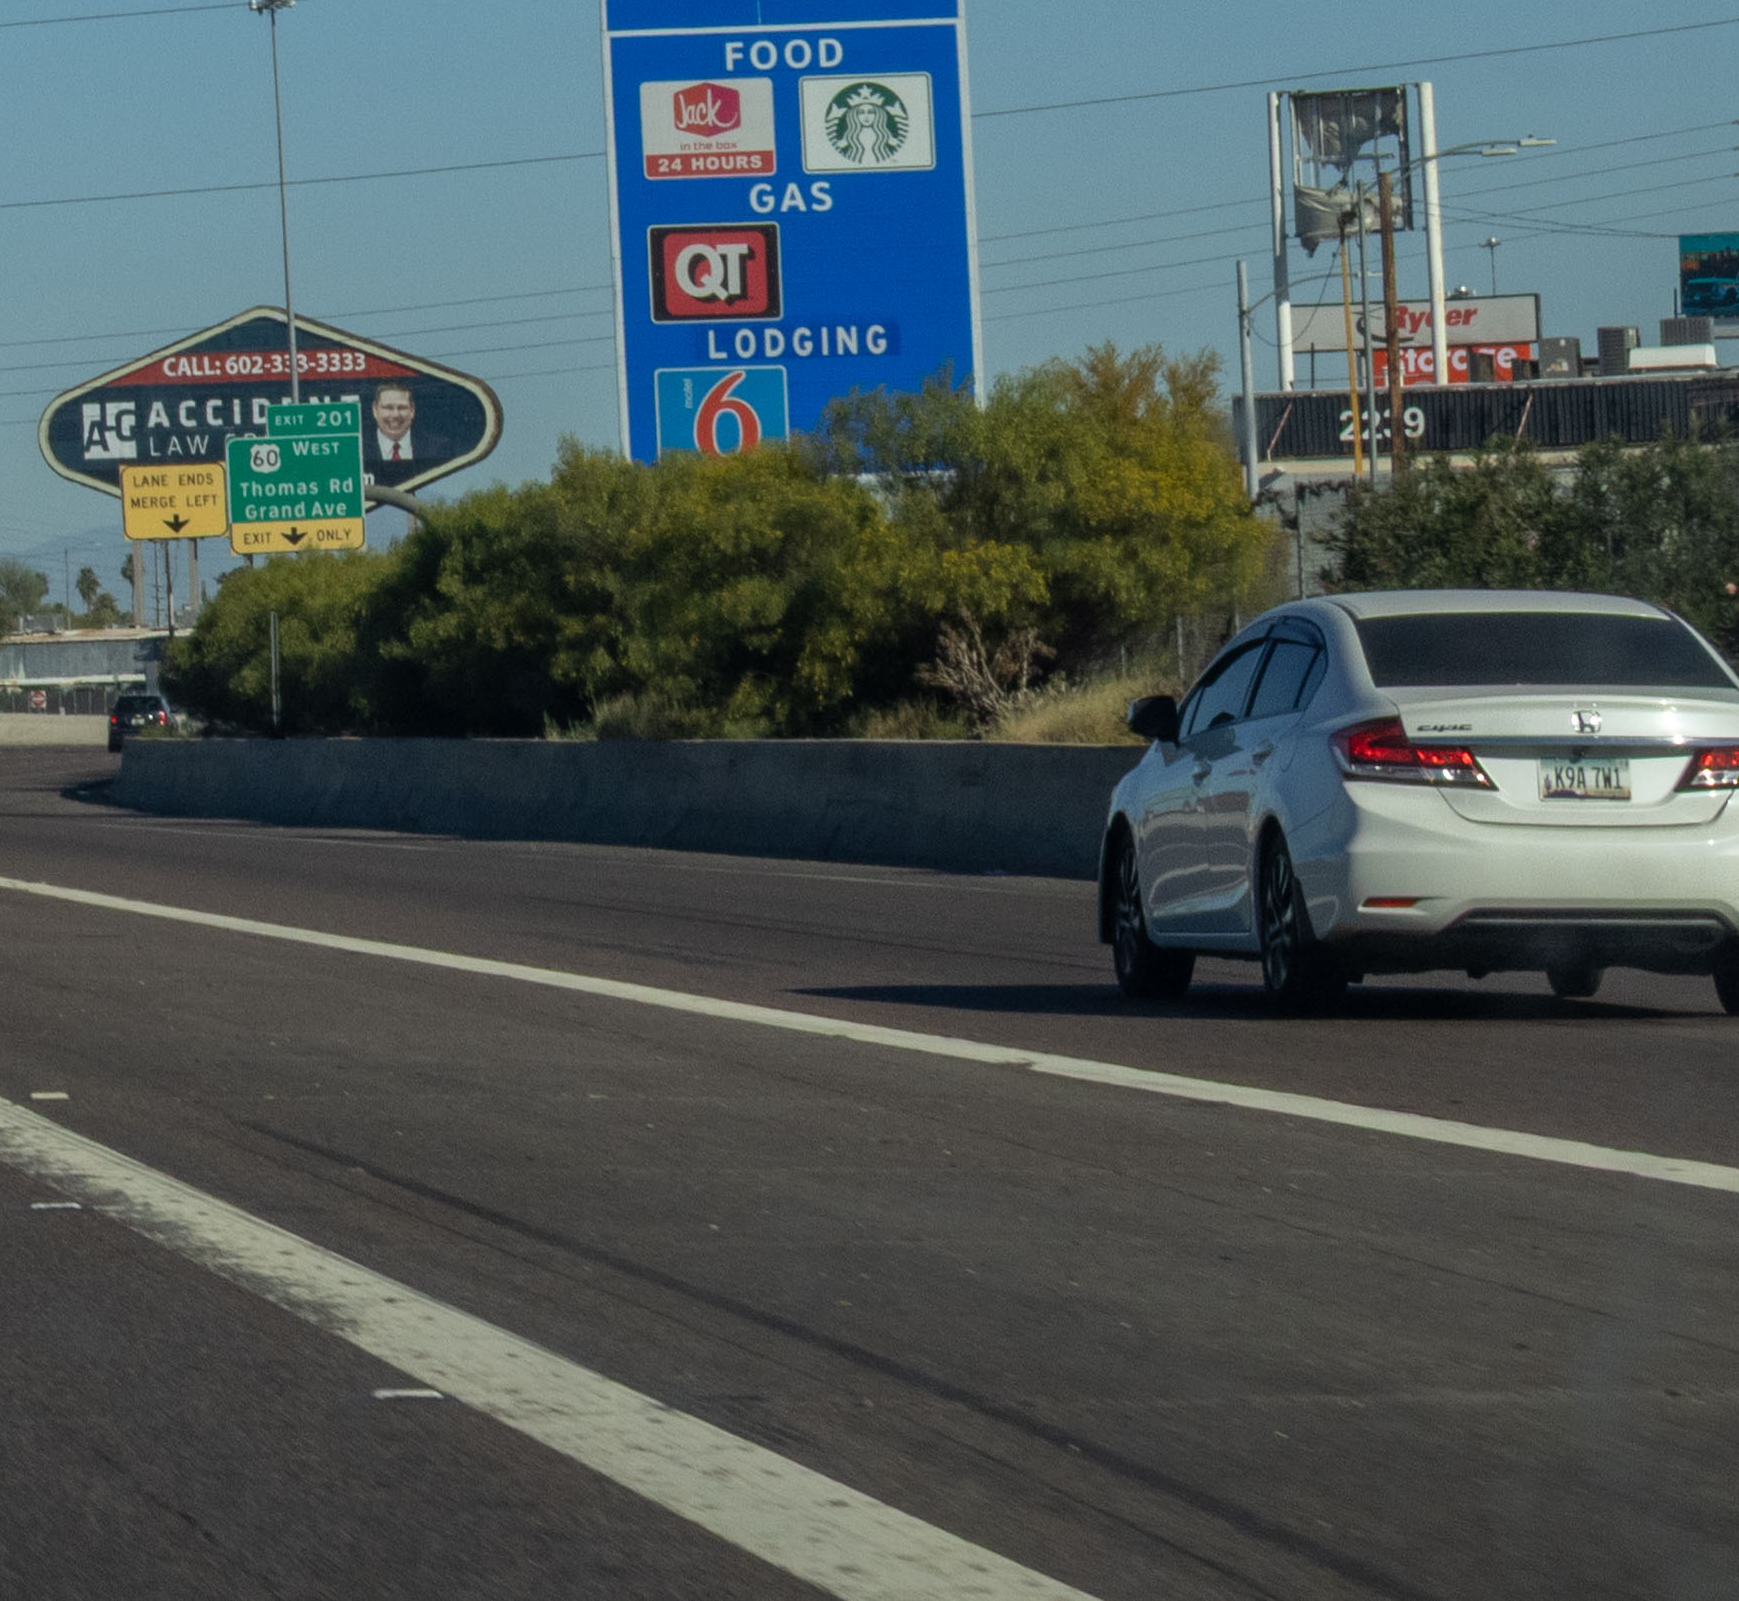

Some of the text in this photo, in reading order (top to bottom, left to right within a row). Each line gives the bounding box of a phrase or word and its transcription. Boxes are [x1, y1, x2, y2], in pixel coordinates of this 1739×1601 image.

[725, 38, 844, 71] FOOD
[676, 88, 739, 130] Jack
[679, 140, 738, 151] in the box
[658, 154, 763, 173] 24 HOURS
[749, 181, 833, 214] GAS
[675, 243, 749, 301] QT
[1395, 305, 1478, 334] Ryer
[708, 324, 888, 360] LODGING
[162, 352, 367, 377] CALL: 602-333-3333
[147, 395, 361, 428] ACCID
[274, 410, 352, 427] EXIT 201
[693, 369, 762, 460] 6
[149, 434, 209, 457] LAW
[253, 441, 340, 467] 60 WEST
[133, 473, 214, 488] LANE ENDS
[240, 480, 319, 498] Thomas
[329, 478, 354, 494] Rd
[130, 494, 218, 509] MERGE LEFT
[245, 502, 348, 520] Grand Ave
[243, 528, 352, 545] EXIT ONLY
[1554, 766, 1587, 789] K9A
